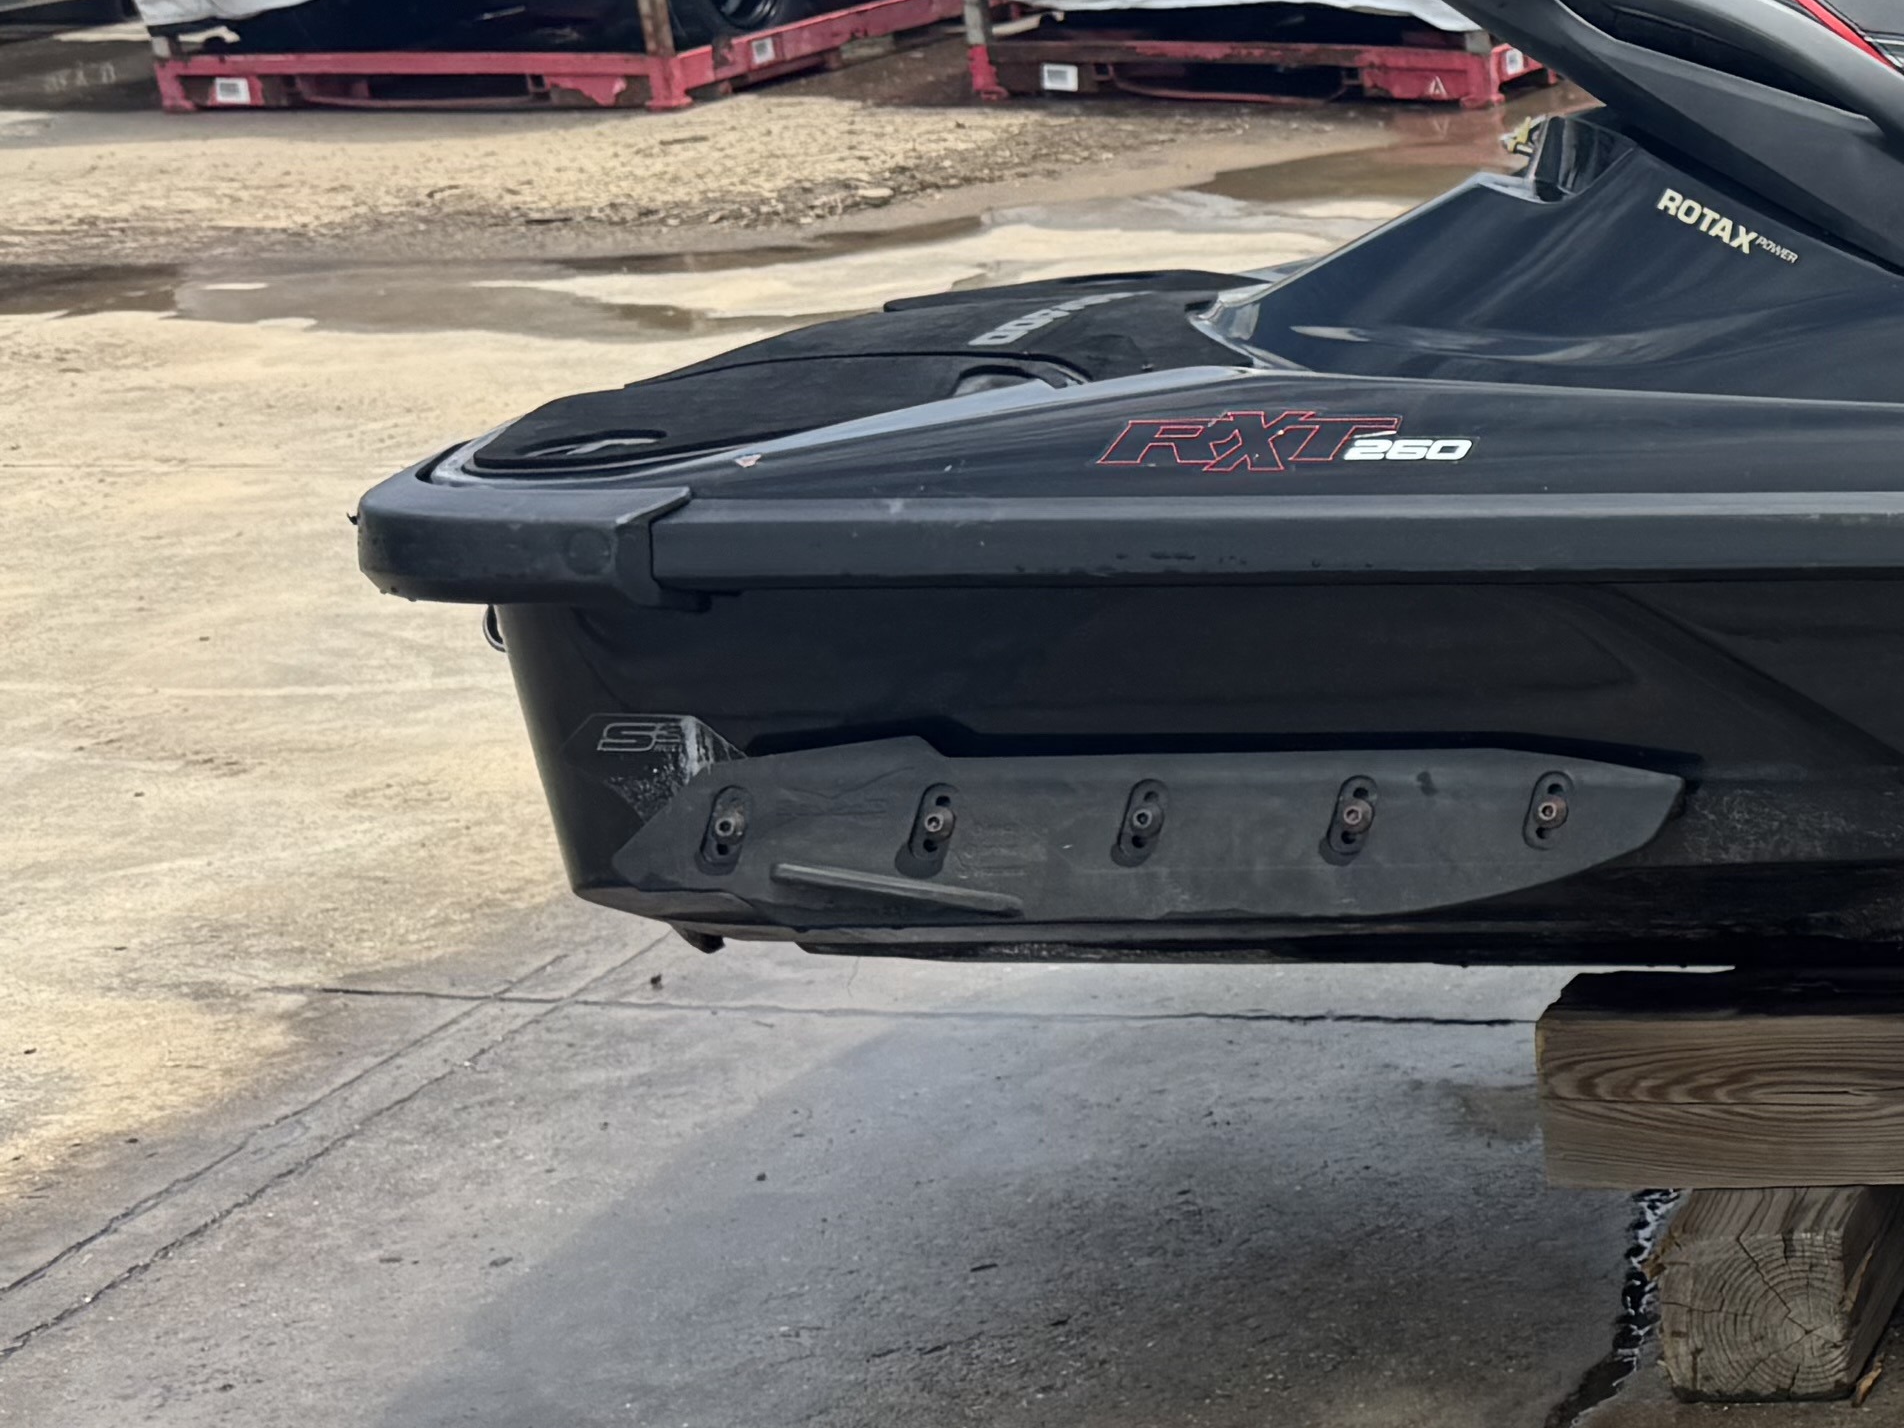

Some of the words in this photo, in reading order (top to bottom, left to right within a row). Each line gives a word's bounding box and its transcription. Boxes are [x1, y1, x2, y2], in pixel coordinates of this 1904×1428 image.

[1656, 188, 1758, 254] ROTAX
[1755, 235, 1798, 264] POWER
[1096, 410, 1402, 472] RXT
[1343, 438, 1474, 461] 260
